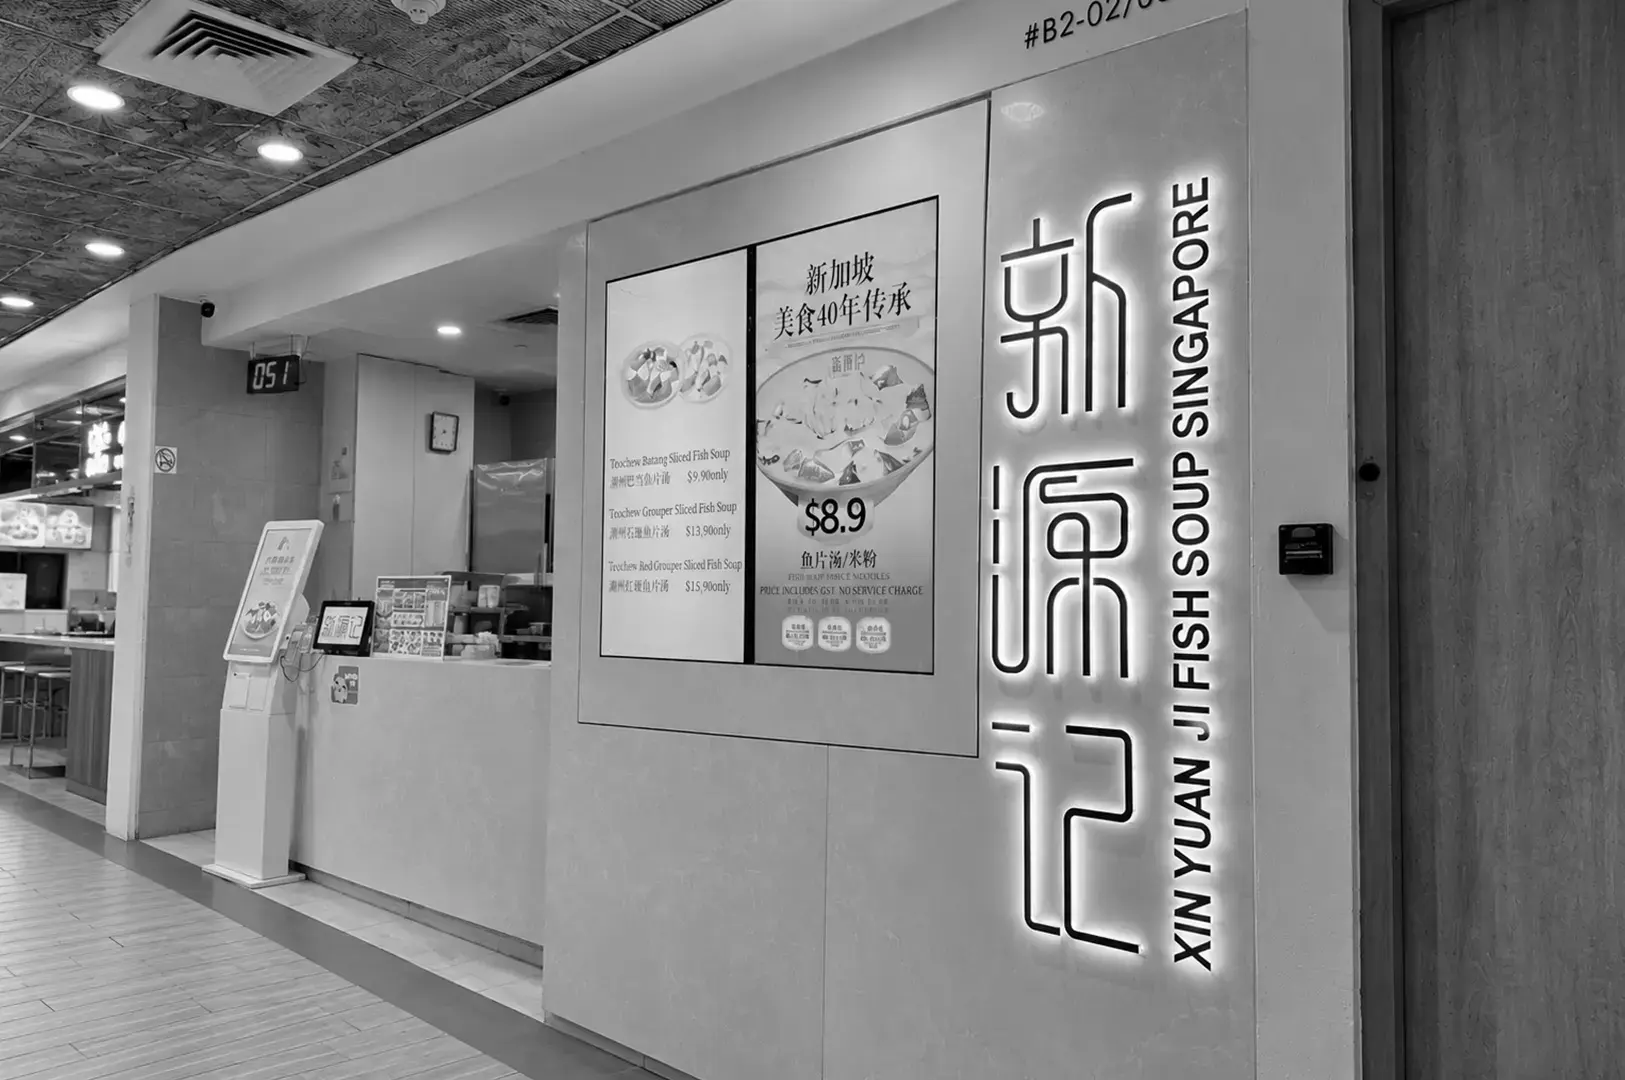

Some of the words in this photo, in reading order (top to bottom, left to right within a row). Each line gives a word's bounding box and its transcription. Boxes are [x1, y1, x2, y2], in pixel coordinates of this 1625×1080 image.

[805, 251, 875, 296] 新加坡
[773, 281, 912, 341] 美食40年传承
[1172, 176, 1210, 438] SINGAPORE
[252, 360, 290, 390] 051
[642, 454, 668, 468] Batang
[669, 450, 692, 464] Sliced
[692, 448, 709, 461] Fish
[710, 448, 731, 462] Soup
[642, 505, 673, 519] Grouper
[674, 502, 698, 515] Sliced
[699, 501, 715, 514] Fish
[716, 501, 738, 515] Soup
[805, 497, 867, 536] $8.9
[1172, 451, 1210, 577] SOUP
[639, 560, 653, 571] Red
[653, 559, 682, 573] Grouper
[683, 558, 706, 571] Sliced
[707, 558, 723, 570] Fish
[723, 557, 743, 572] Soup
[800, 549, 877, 570] 鱼片汤/米粉
[759, 585, 780, 596] PRICE
[782, 585, 819, 596] INCLUDES
[839, 585, 850, 596] NO
[852, 585, 887, 596] SERVICE
[888, 585, 924, 596] CHARGE
[1172, 590, 1210, 690] FISH
[1172, 704, 1211, 742] JI
[1173, 757, 1212, 878] YUAN
[1173, 890, 1212, 971] XIN
